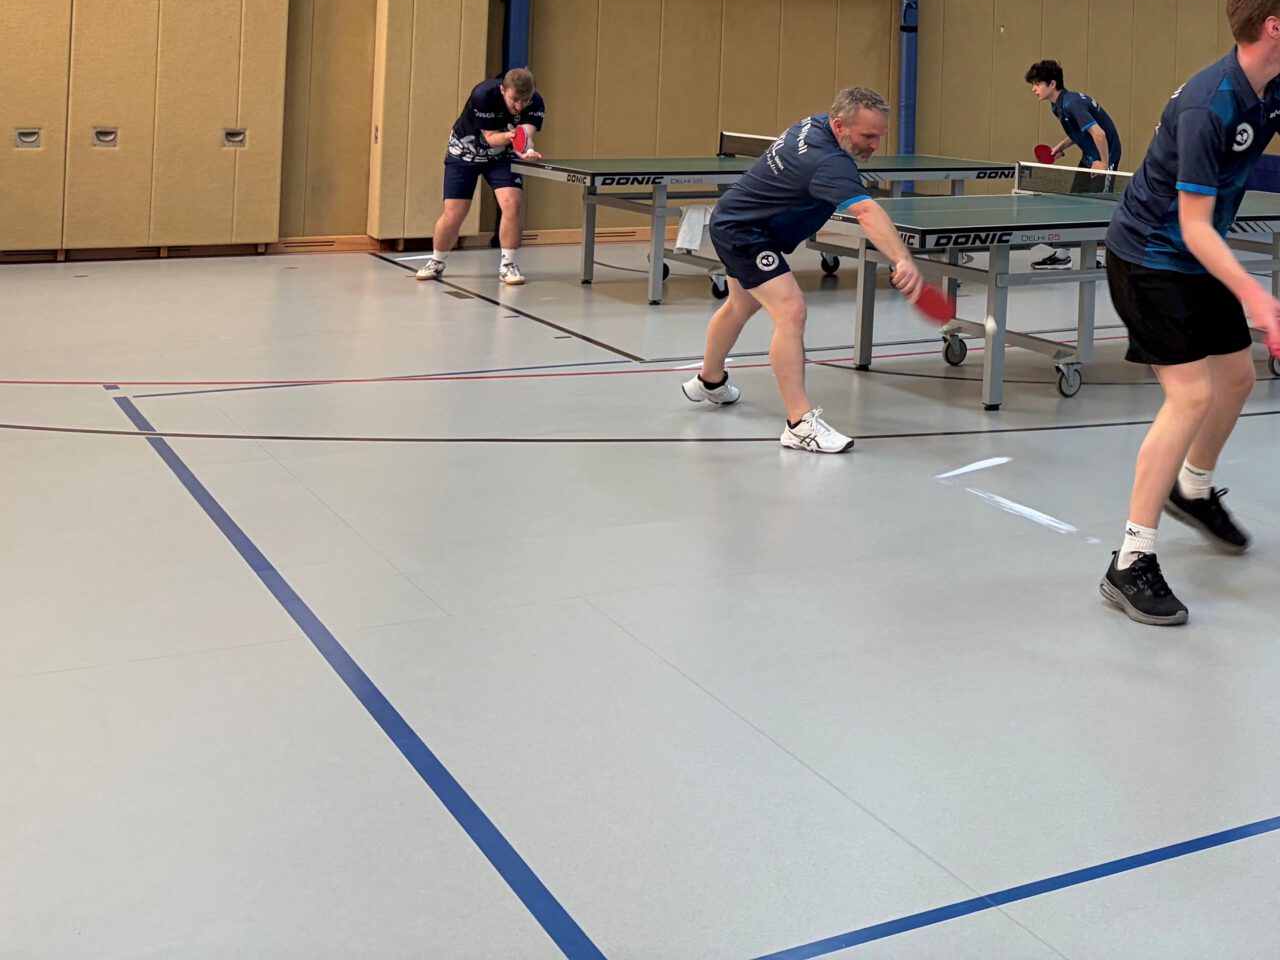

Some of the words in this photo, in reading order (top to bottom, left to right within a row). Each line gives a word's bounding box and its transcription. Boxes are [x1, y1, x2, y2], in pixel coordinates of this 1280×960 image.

[566, 173, 587, 185] DONIC
[975, 169, 1025, 179] DONI
[601, 176, 664, 186] DONIC
[934, 231, 1013, 247] DONIC
[1047, 233, 1061, 241] 25
